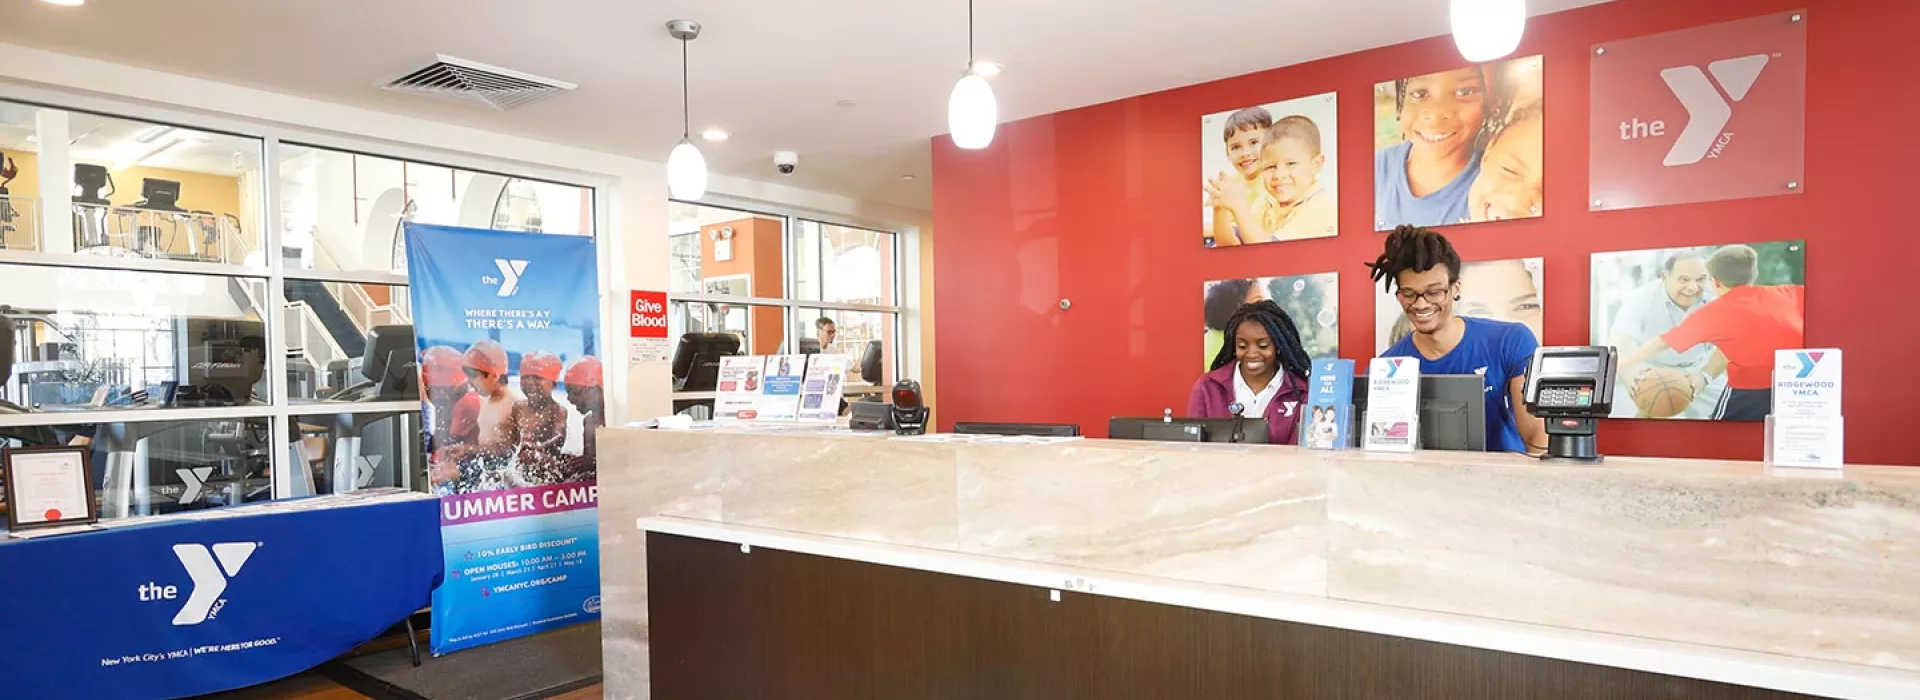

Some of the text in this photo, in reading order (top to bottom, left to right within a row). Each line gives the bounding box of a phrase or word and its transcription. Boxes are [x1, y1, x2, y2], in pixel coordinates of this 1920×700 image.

[1619, 117, 1665, 140] the
[1707, 130, 1735, 160] YMCA
[482, 275, 499, 285] the
[465, 309, 497, 317] WHERE
[499, 309, 534, 318] THERE'S
[543, 310, 551, 318] Y
[635, 298, 662, 313] Give
[465, 319, 551, 329] THERE'S A WAY
[632, 313, 666, 327] Blood
[1777, 381, 1835, 389] RIDGEWOOD
[160, 485, 179, 495] the
[443, 485, 599, 520] UMMER CAMP
[477, 550, 495, 559] 10%
[495, 545, 519, 556] EARLY
[520, 542, 538, 552] BIRD
[464, 565, 485, 576] OPEN
[541, 555, 553, 563] AM
[138, 581, 177, 602] the
[493, 574, 568, 594] YMCANYC.ORG/CAMP
[207, 598, 228, 620] YMCA
[101, 657, 121, 667] New
[121, 655, 141, 664] York
[142, 652, 165, 664] City's
[167, 649, 189, 660] YMCA
[194, 644, 220, 655] WE'RE
